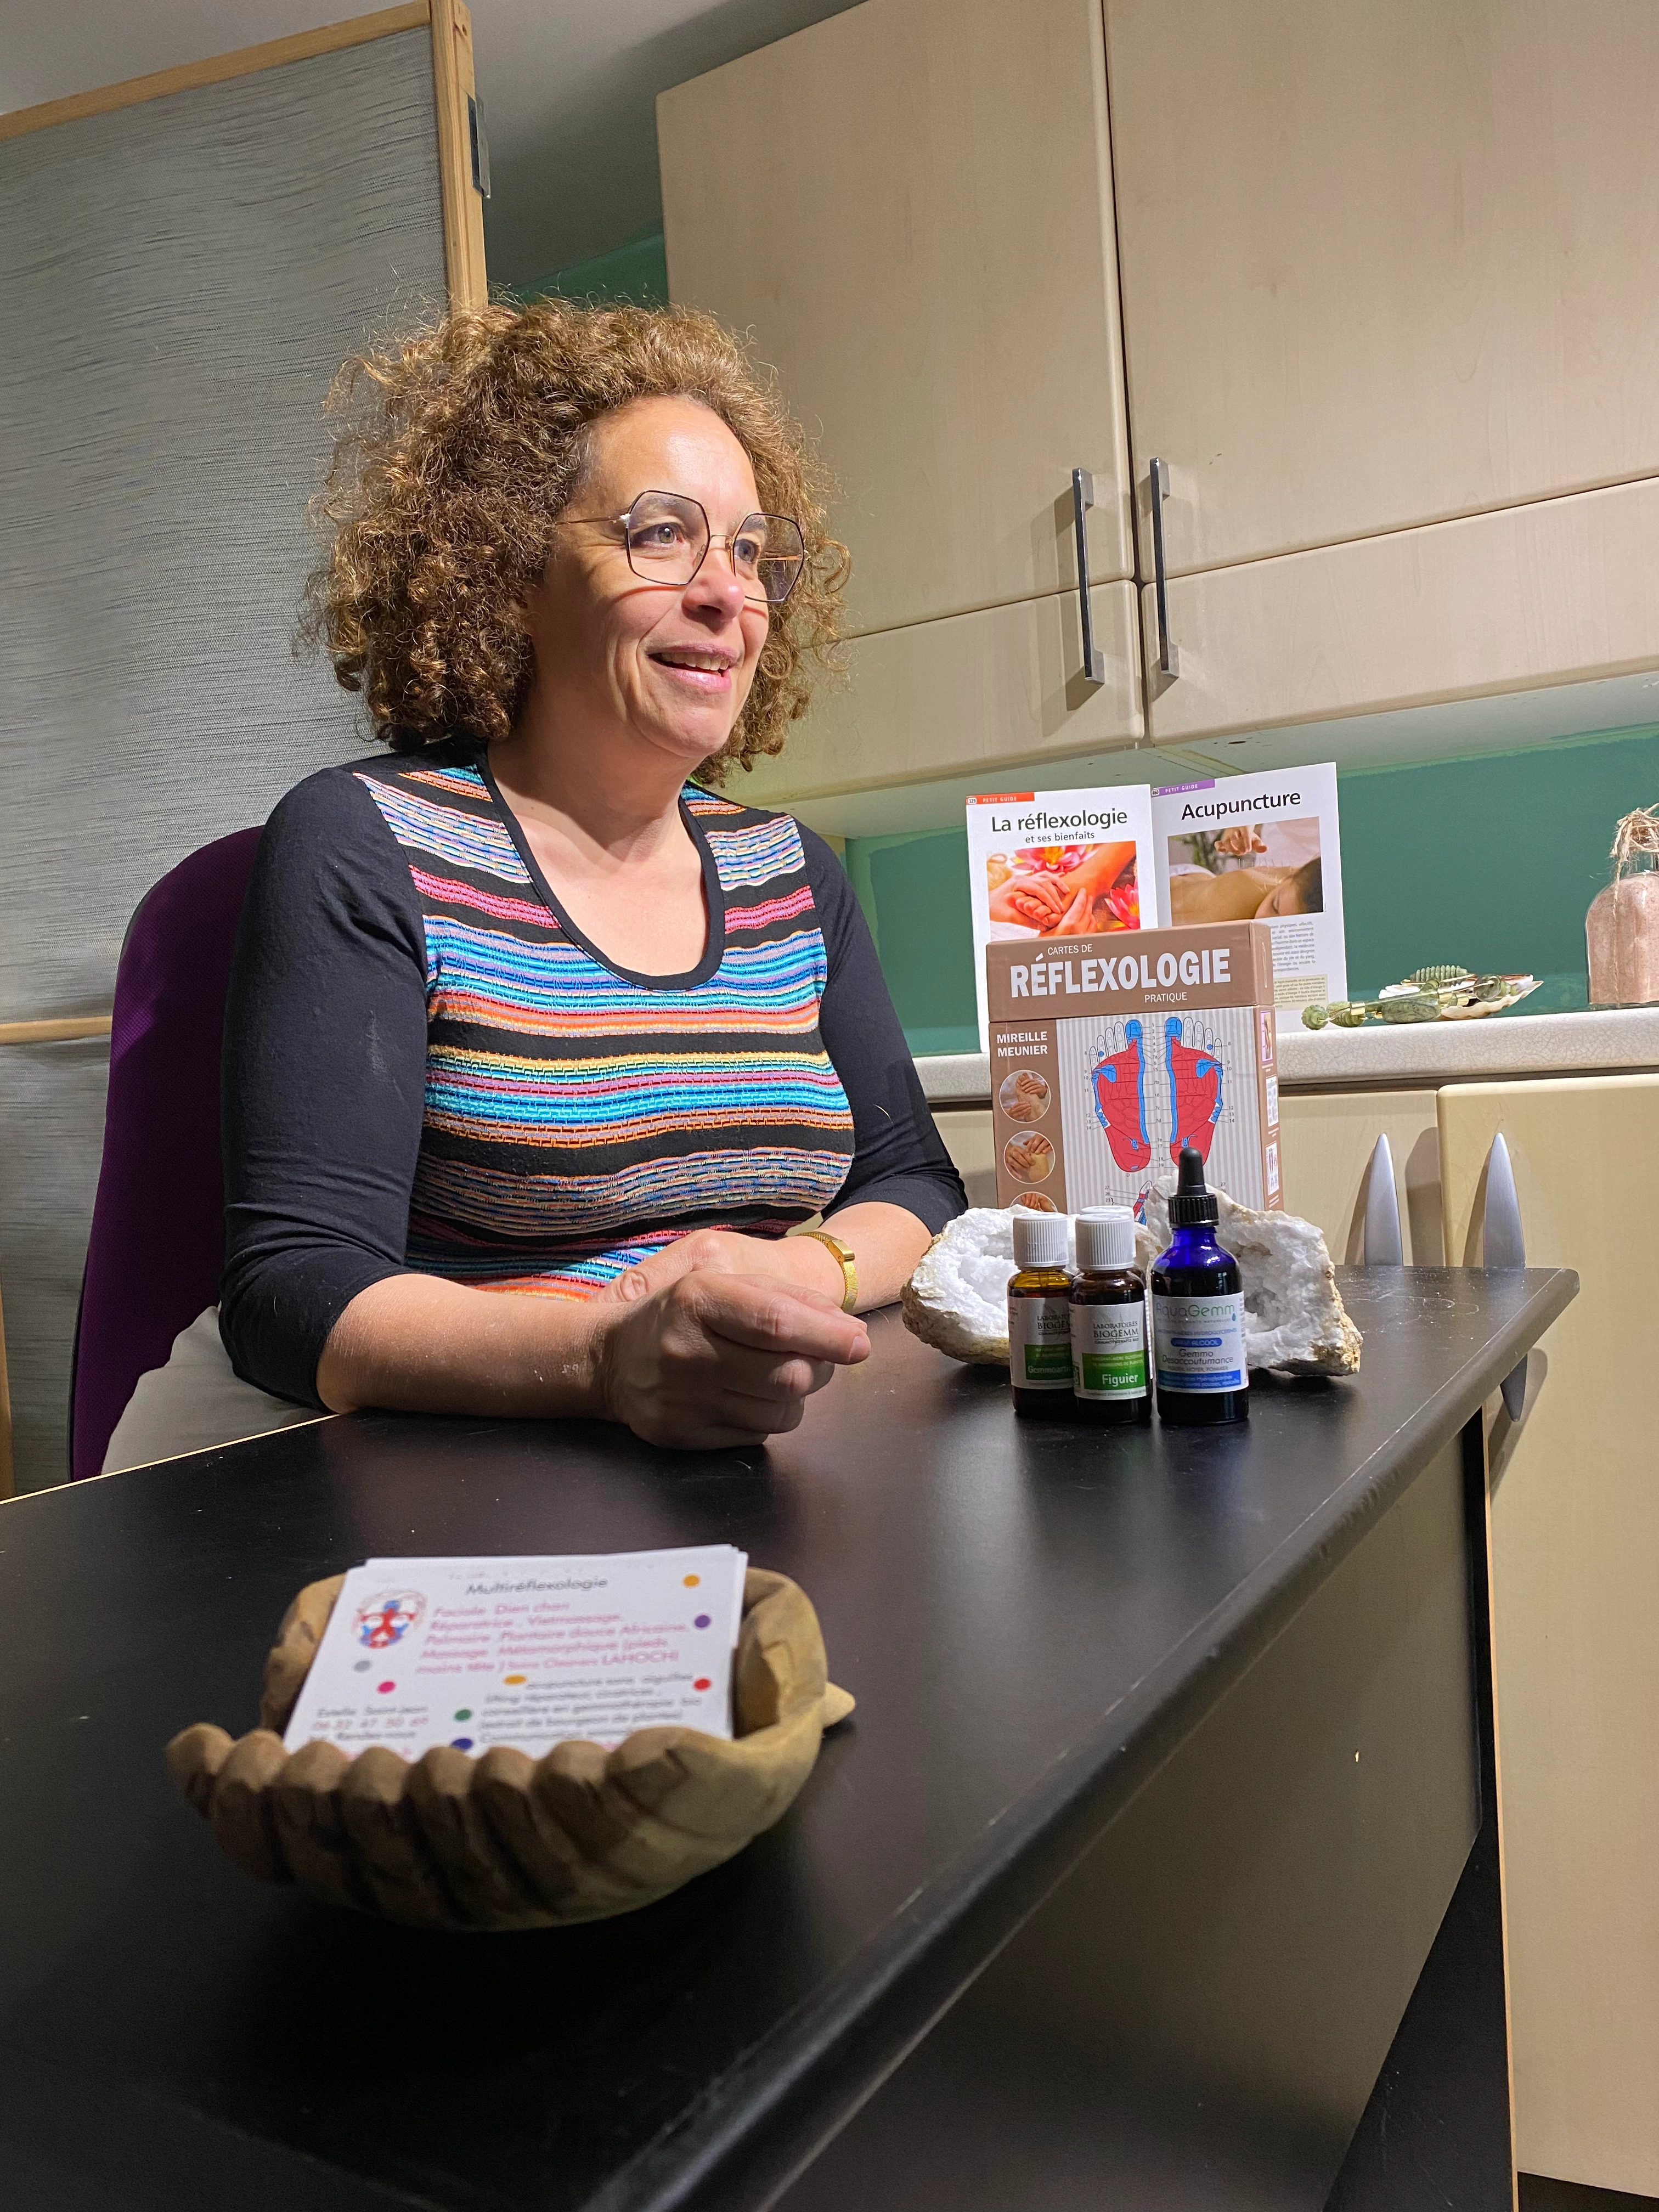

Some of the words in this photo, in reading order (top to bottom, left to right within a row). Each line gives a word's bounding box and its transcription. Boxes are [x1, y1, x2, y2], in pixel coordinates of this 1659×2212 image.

[1181, 792, 1301, 820] Acupuncture
[991, 816, 1011, 832] La
[1018, 808, 1127, 831] réflexologie
[1055, 831, 1094, 841] bienfaits
[1047, 945, 1079, 956] CARTES
[1081, 944, 1093, 953] DE
[1010, 948, 1231, 998] RÉFLEXOLOGIE
[1144, 992, 1188, 1003] PRATIQUE
[997, 1031, 1047, 1043] MIREILLE
[997, 1045, 1048, 1057] MEUNIER
[1156, 1302, 1234, 1318] AquaGemm
[1037, 1321, 1070, 1329] BIOGE
[1093, 1328, 1138, 1338] BIOGEMM
[1179, 1348, 1214, 1358] Gemmo
[1102, 1373, 1138, 1387] Figuier
